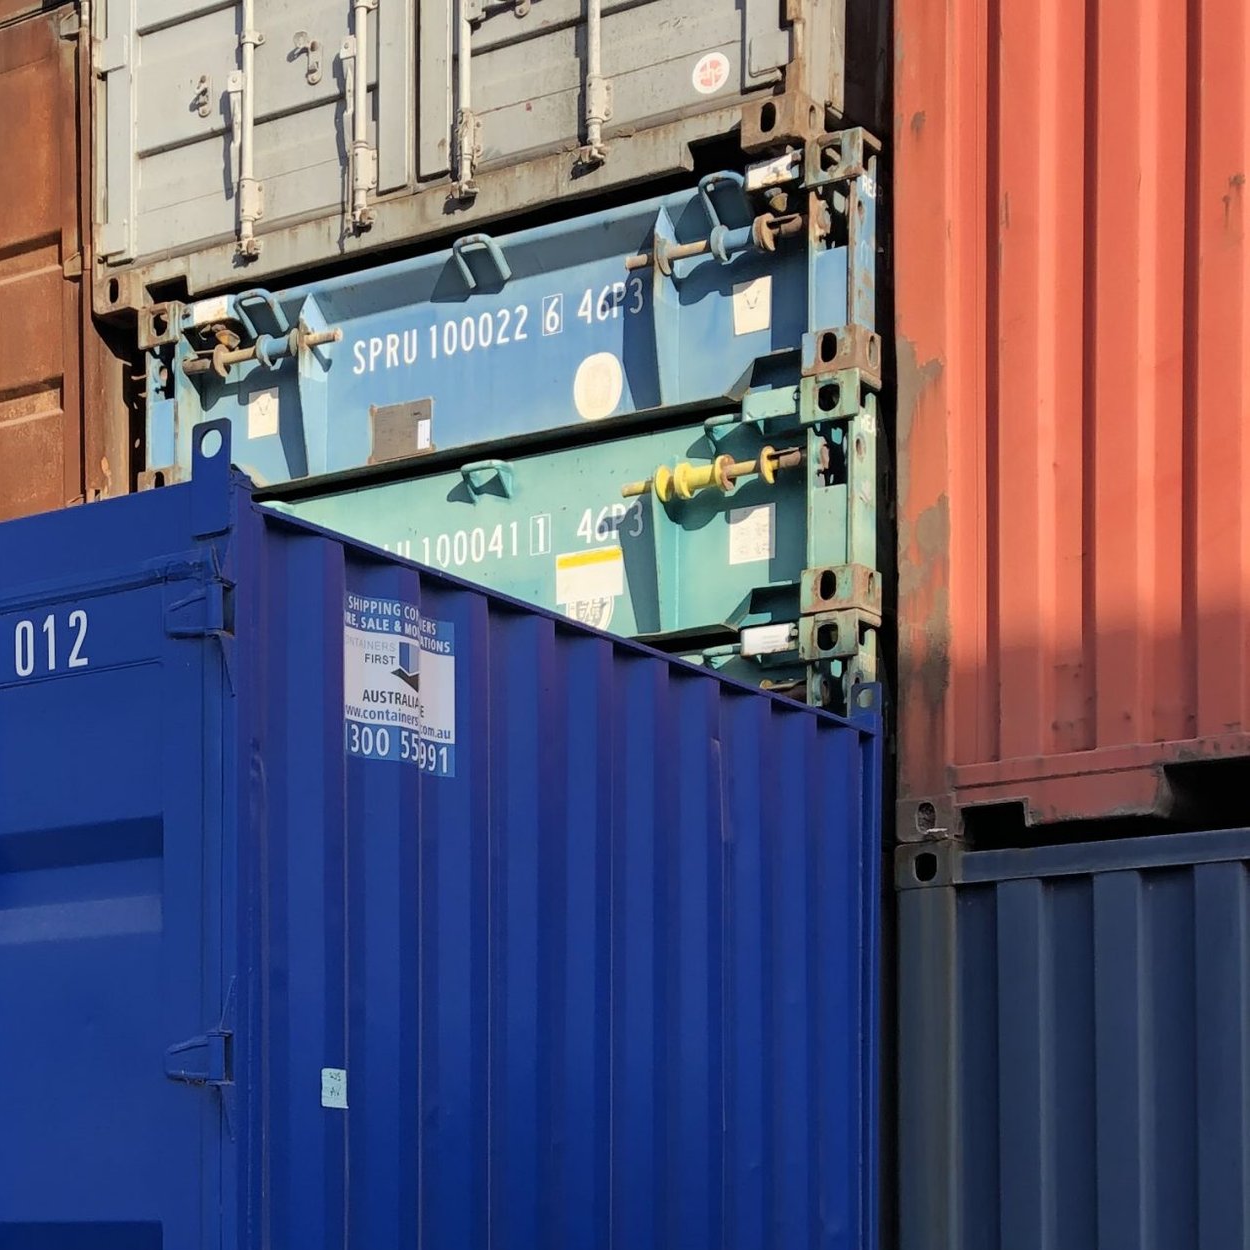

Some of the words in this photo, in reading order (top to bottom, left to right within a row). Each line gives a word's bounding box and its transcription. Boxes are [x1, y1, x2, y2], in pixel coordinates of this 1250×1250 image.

[353, 329, 417, 375] SPRU
[430, 304, 528, 359] 100022
[545, 296, 560, 332] 6
[577, 277, 644, 325] 46P3
[422, 521, 519, 568] 100041
[536, 516, 546, 552] 1
[577, 500, 644, 544] 46P3
[348, 595, 401, 617] SHIPPING
[361, 616, 389, 631] SALE
[394, 619, 402, 633] &
[15, 610, 89, 677] 012
[364, 653, 396, 666] FIRST
